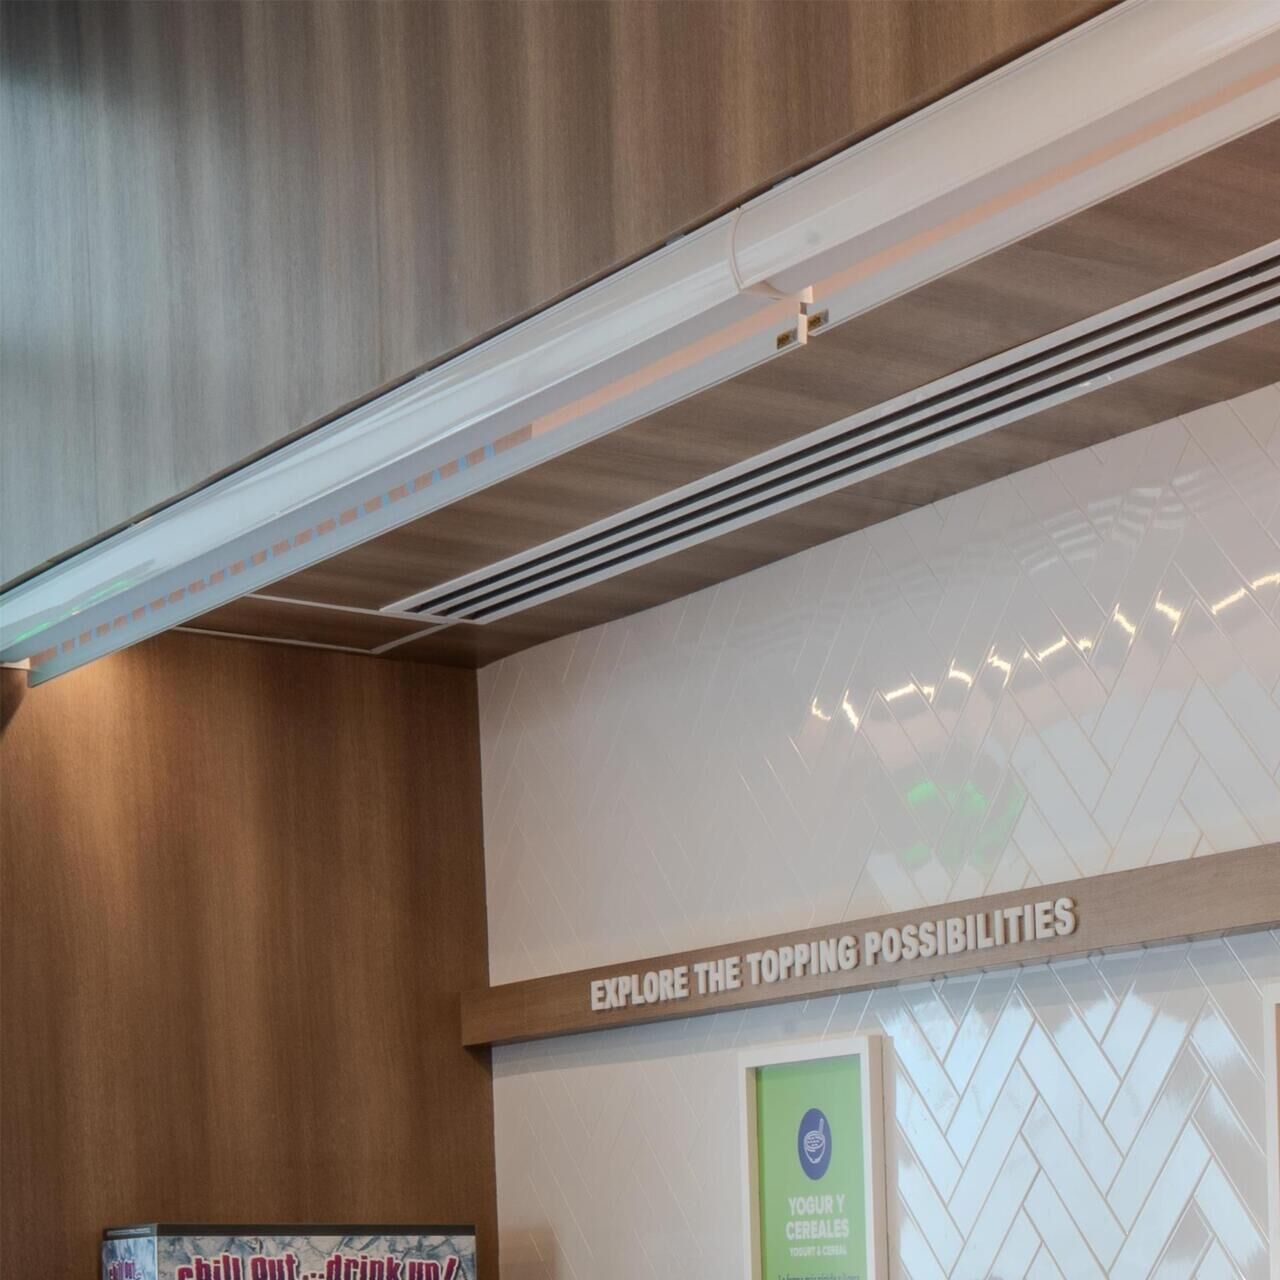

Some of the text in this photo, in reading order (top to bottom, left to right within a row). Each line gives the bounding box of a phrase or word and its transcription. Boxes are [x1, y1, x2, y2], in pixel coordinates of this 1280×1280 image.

[590, 897, 1077, 1011] EXPLORE THE TOPPING POSSIBILITIES
[788, 1193, 845, 1216] YOGUR Y
[786, 1219, 848, 1240] CEREALES
